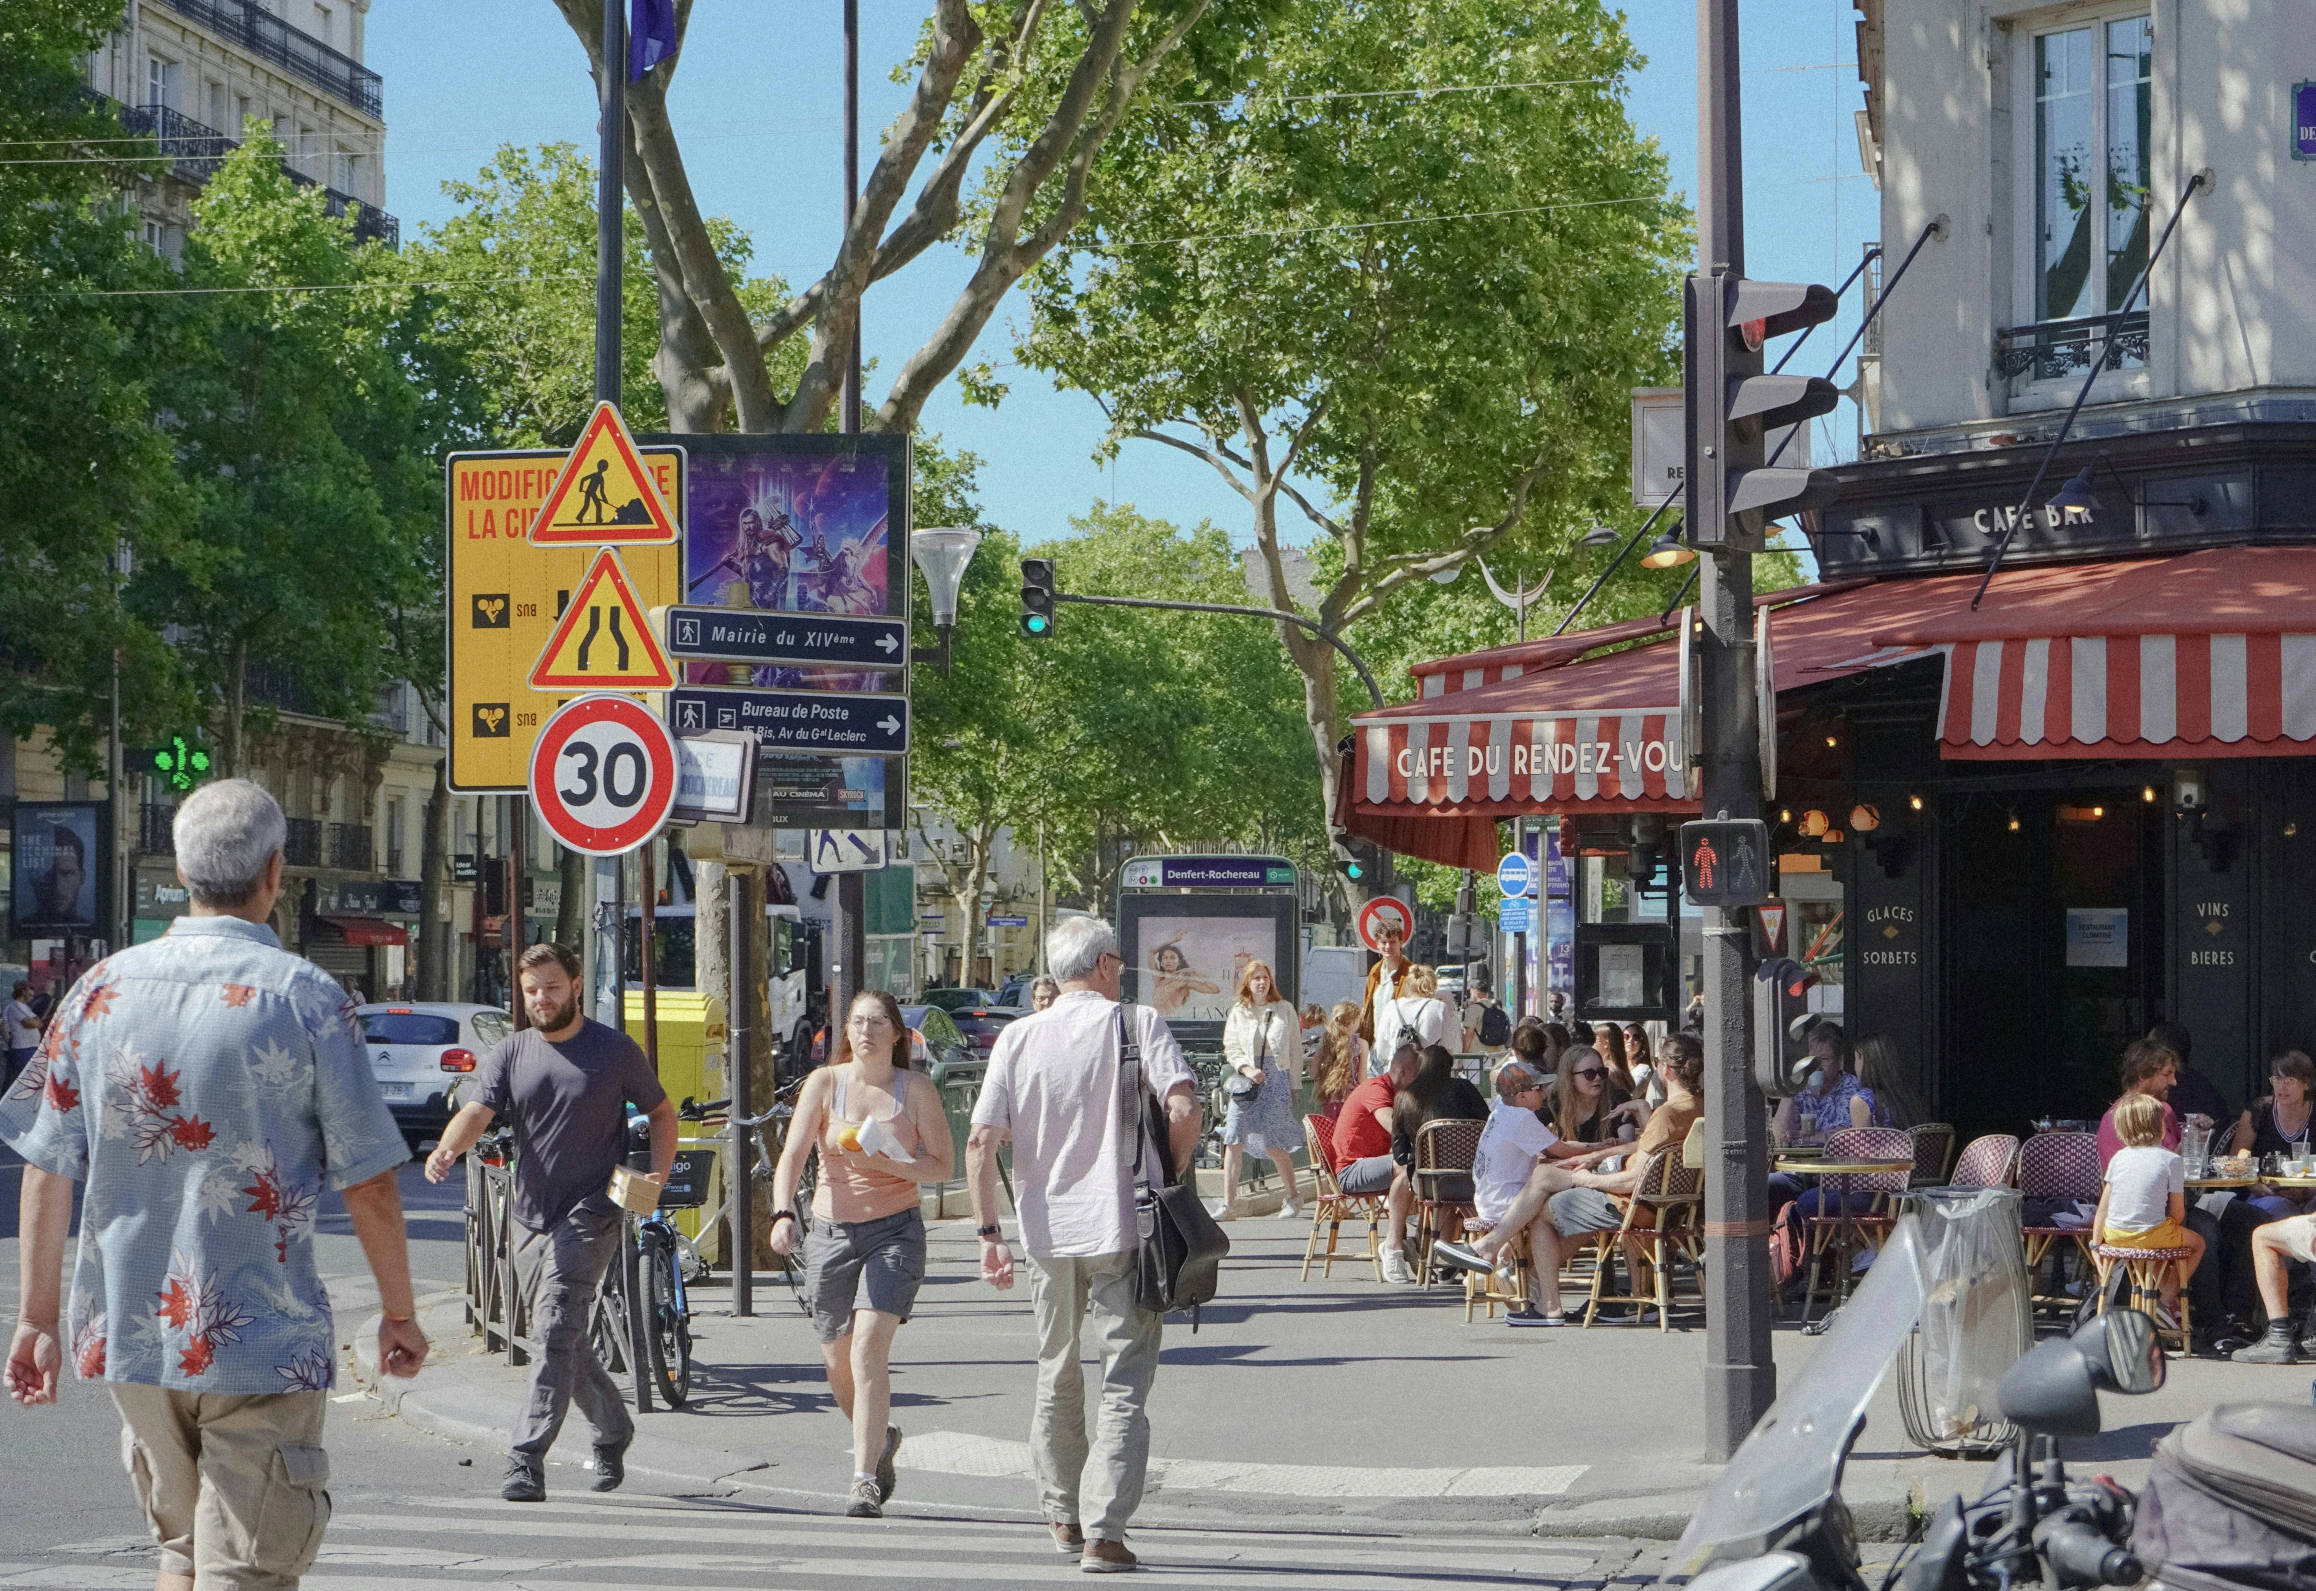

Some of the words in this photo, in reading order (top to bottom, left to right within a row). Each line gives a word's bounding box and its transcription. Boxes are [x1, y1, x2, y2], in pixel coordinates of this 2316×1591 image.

[468, 508, 497, 540] LA
[516, 604, 537, 617] BUS
[711, 626, 767, 644] Mairie
[776, 631, 796, 645] du
[741, 701, 790, 718] Bureau
[792, 703, 808, 719] de
[811, 704, 849, 720] Poste
[516, 713, 537, 726] BUS
[759, 725, 776, 740] Bis,
[778, 728, 793, 740] Av
[796, 728, 809, 740] du
[828, 730, 867, 742] Leclerc
[1397, 746, 1455, 778] CAFE
[1468, 745, 1501, 776] DU
[560, 741, 647, 808] 30
[789, 790, 826, 798] CINÉMA
[22, 835, 41, 846] THE
[22, 857, 46, 869] LIST
[1167, 869, 1260, 879] Denfert-Rochereau
[1867, 906, 1914, 922] GLACES
[2197, 902, 2229, 917] VINS
[1560, 944, 1570, 953] 13
[1863, 951, 1917, 965] SORBETS
[2191, 951, 2234, 965] BIERES
